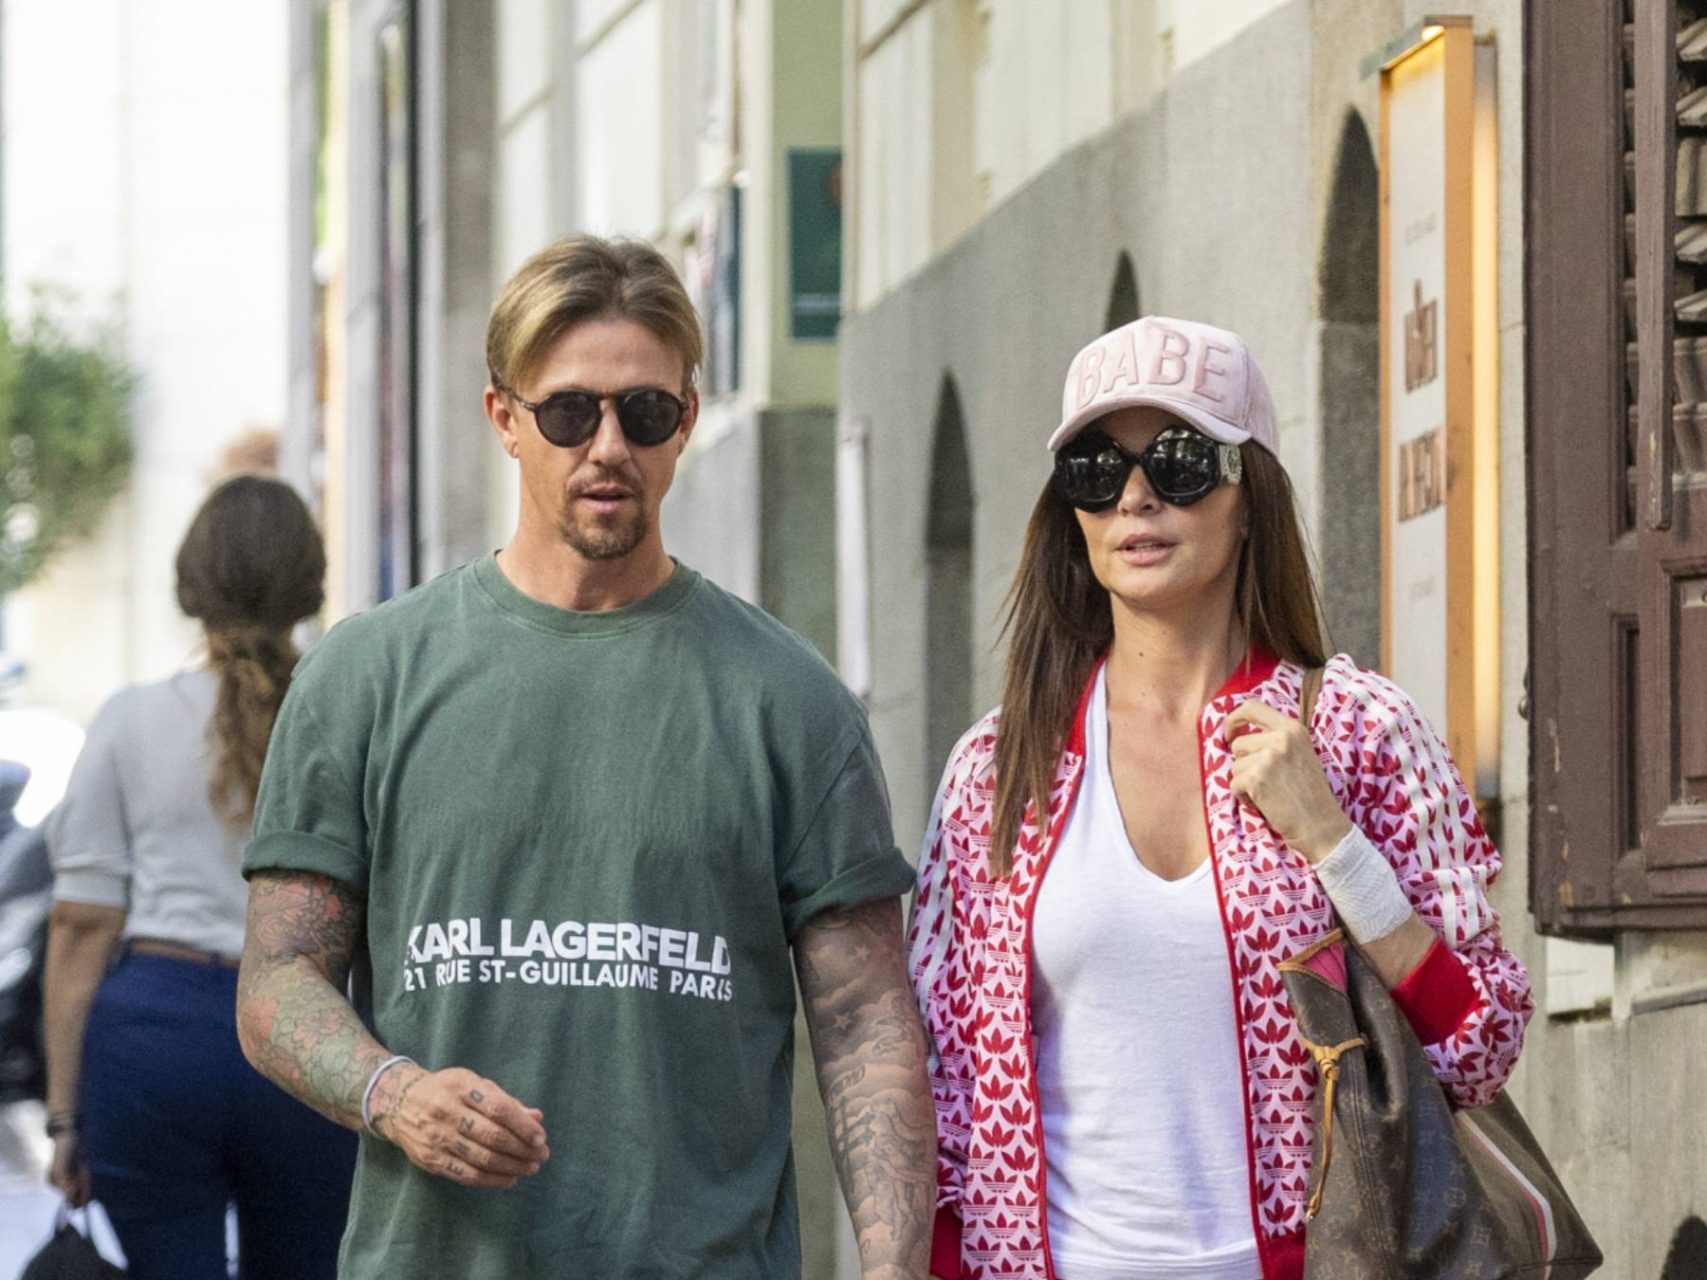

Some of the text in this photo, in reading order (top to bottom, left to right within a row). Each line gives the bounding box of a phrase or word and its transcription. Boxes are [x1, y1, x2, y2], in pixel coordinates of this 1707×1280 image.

[1077, 325, 1231, 412] BABE
[405, 918, 732, 976] KARL LAGERFELD
[403, 959, 733, 1001] 21 RUE ST-GUILLAUME PARIS
